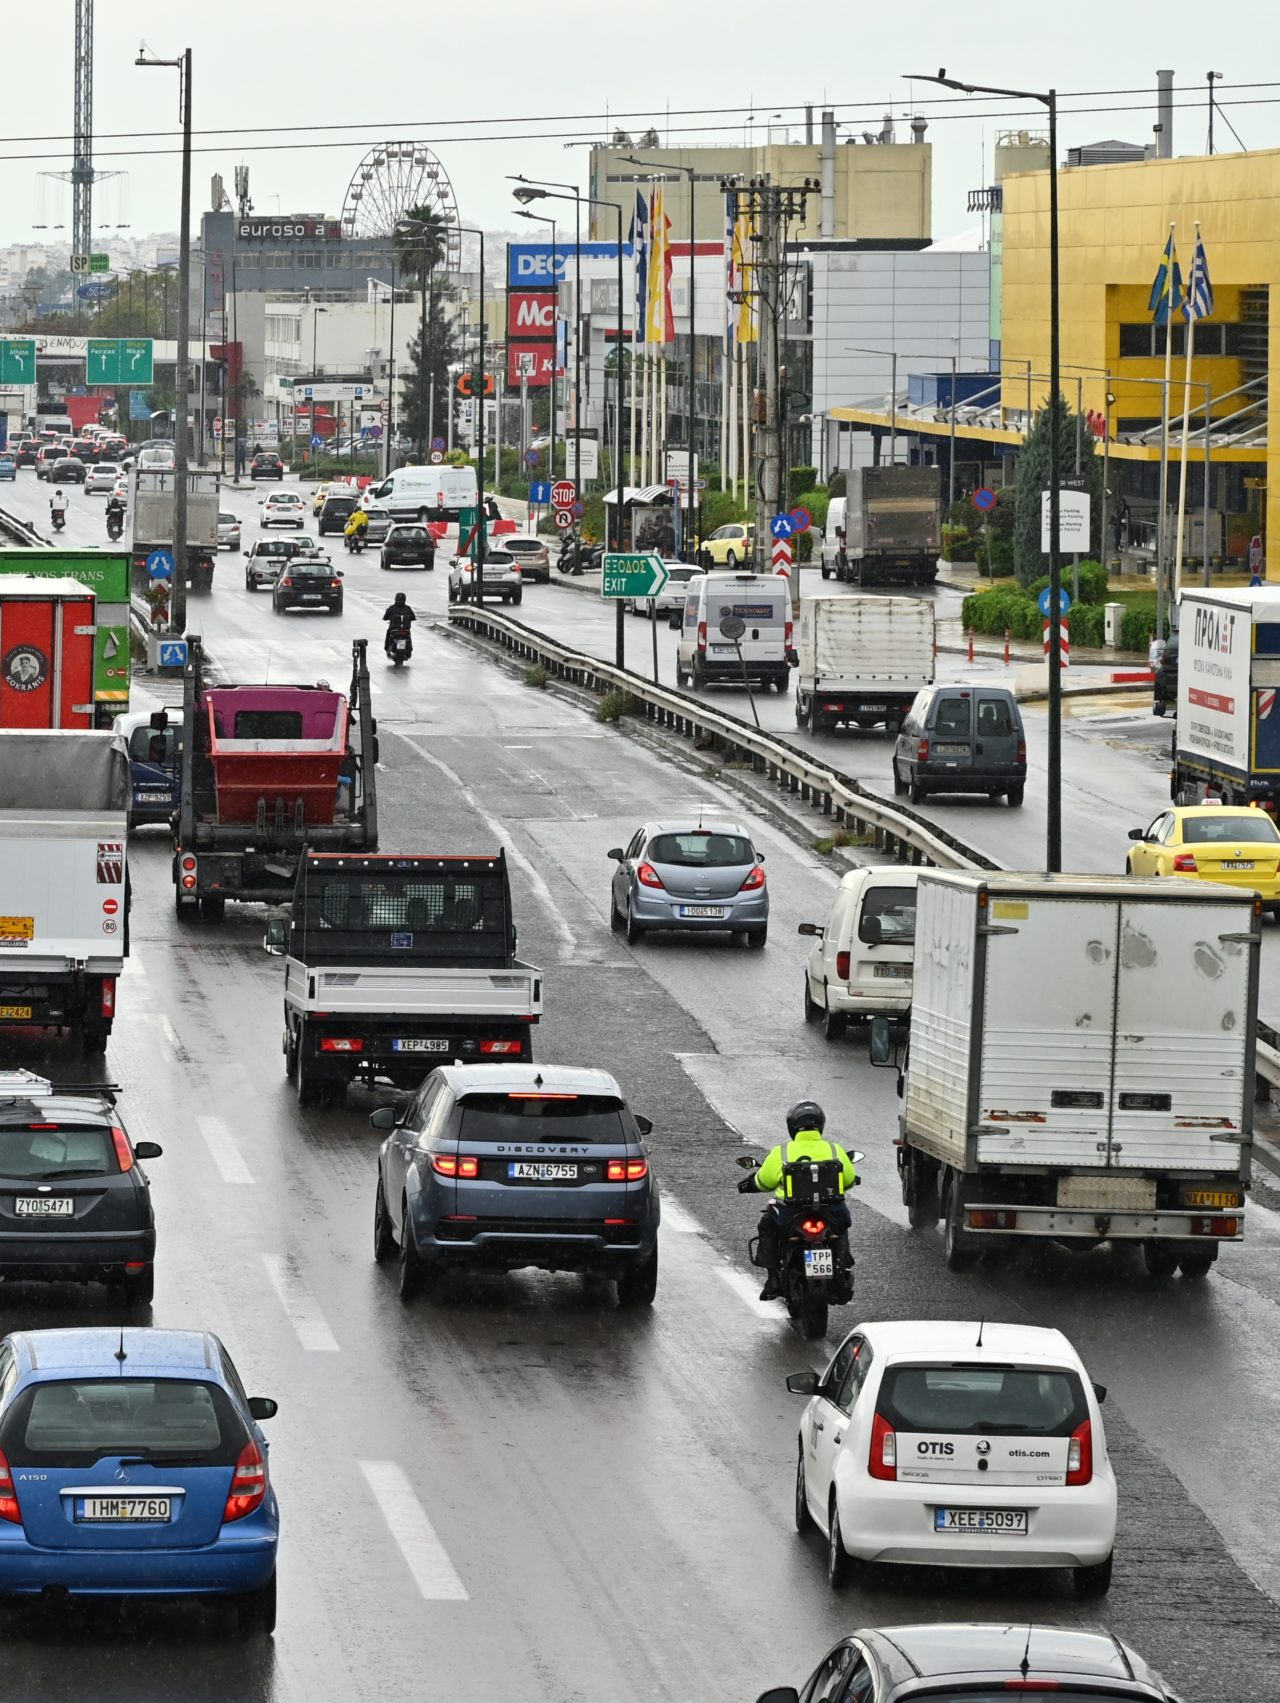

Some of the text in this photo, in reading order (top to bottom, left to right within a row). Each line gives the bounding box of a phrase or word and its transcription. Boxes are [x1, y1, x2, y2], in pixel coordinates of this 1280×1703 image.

[552, 488, 575, 502] STOP
[605, 560, 647, 574] ΕΞΟΔΟΣ
[604, 578, 627, 592] EXIT
[5, 674, 45, 691] KOKRANIS
[105, 922, 114, 930] 80
[496, 1145, 590, 1154] DISCOVERY
[812, 1251, 832, 1262] TPP
[812, 1264, 832, 1274] 566
[917, 1441, 955, 1455] OTIS
[1008, 1448, 1051, 1458] otis.com
